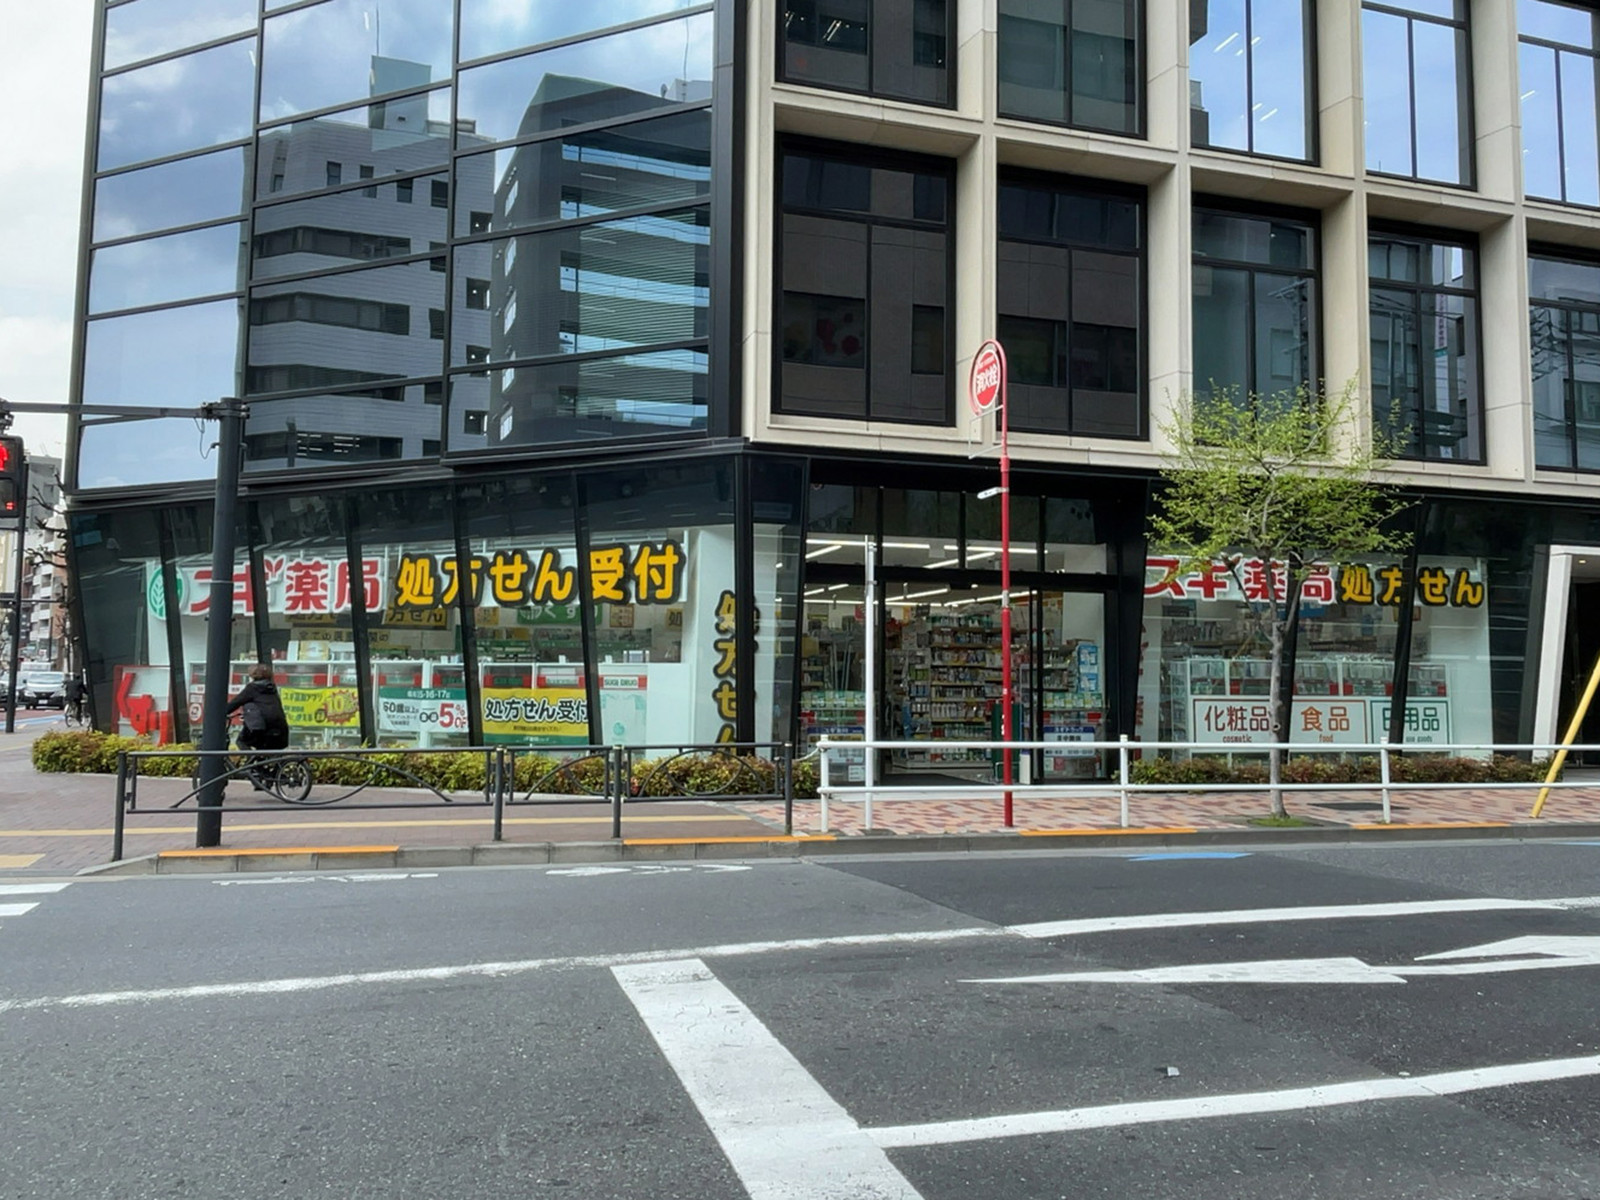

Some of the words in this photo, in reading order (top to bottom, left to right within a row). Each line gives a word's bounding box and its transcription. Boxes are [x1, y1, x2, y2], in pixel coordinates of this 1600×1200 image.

[396, 541, 682, 608] 処方せん受付
[1144, 557, 1333, 602] スギ薬局
[1339, 564, 1485, 606] 処方せん
[486, 699, 588, 721] 処方せん受付
[1204, 705, 1270, 732] 化粧品
[1300, 706, 1350, 732] 食品
[1222, 733, 1252, 744] cosmetic
[1319, 733, 1334, 743] food
